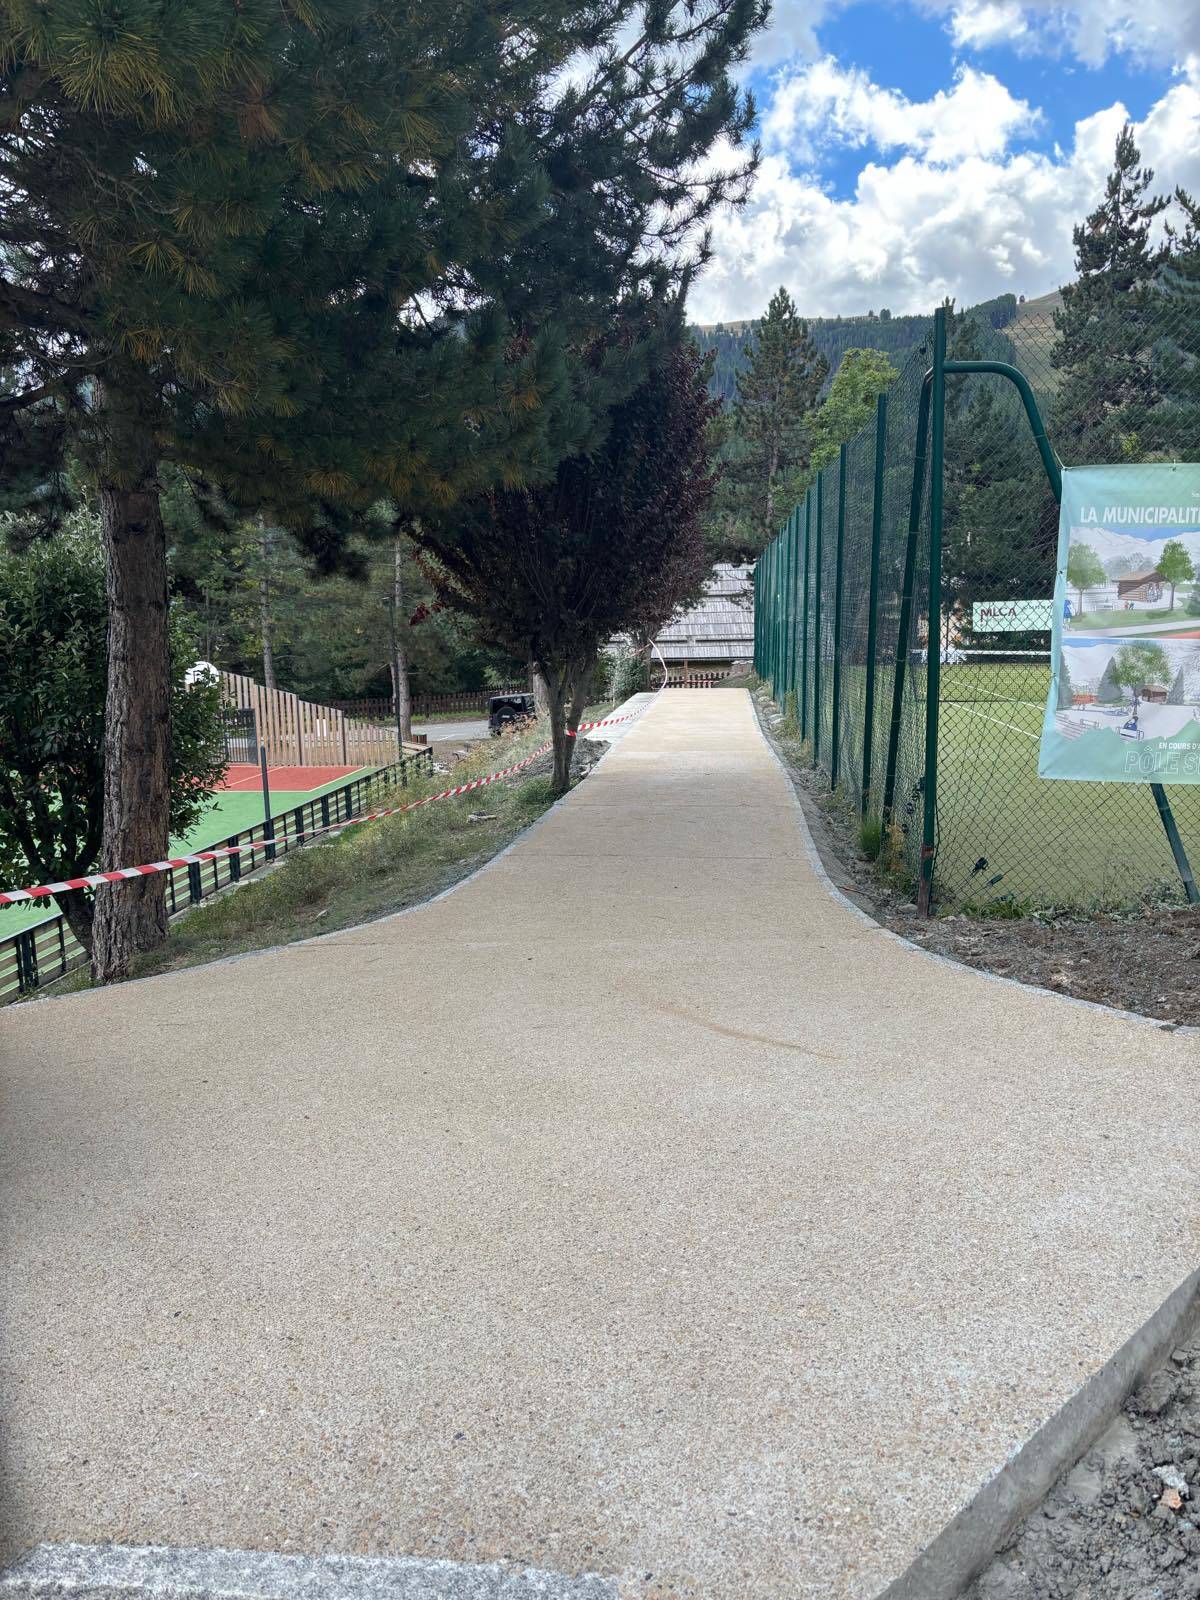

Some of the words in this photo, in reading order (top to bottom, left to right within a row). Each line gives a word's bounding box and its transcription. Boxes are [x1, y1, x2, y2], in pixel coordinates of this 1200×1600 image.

[1080, 506, 1098, 523] LA
[1159, 742, 1168, 750] EN
[1168, 742, 1191, 750] COURS
[1124, 745, 1181, 774] PÔLE
[1183, 751, 1200, 775] S
